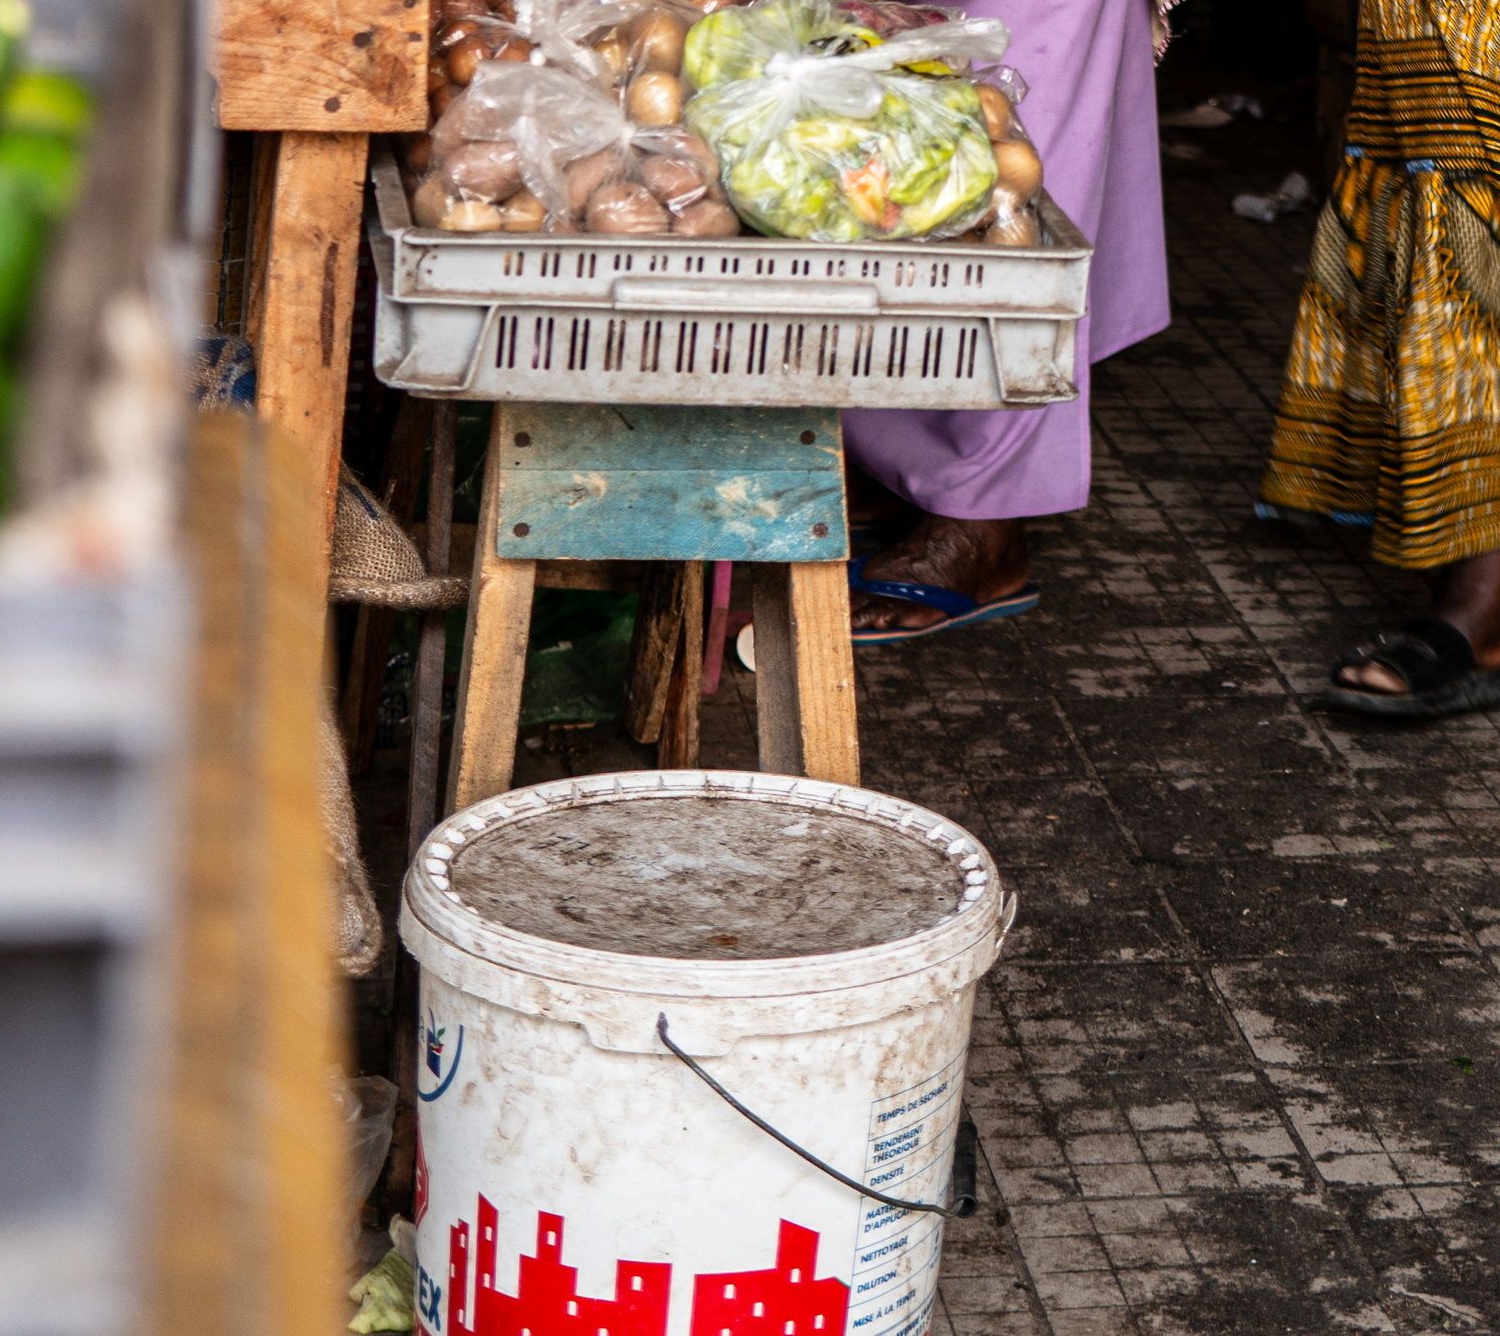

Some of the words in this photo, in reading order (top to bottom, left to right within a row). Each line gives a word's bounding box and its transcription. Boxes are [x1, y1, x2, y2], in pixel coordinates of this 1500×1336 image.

[877, 1105, 905, 1124] TEMPS
[907, 1101, 918, 1112] DE
[873, 1124, 924, 1153] RENDEMENT
[860, 1235, 909, 1265] NETTOYAGE
[856, 1269, 897, 1294] DILUTION
[852, 1313, 874, 1329] MISE
[884, 1304, 894, 1315] LA
[896, 1287, 916, 1309] TEINTE
